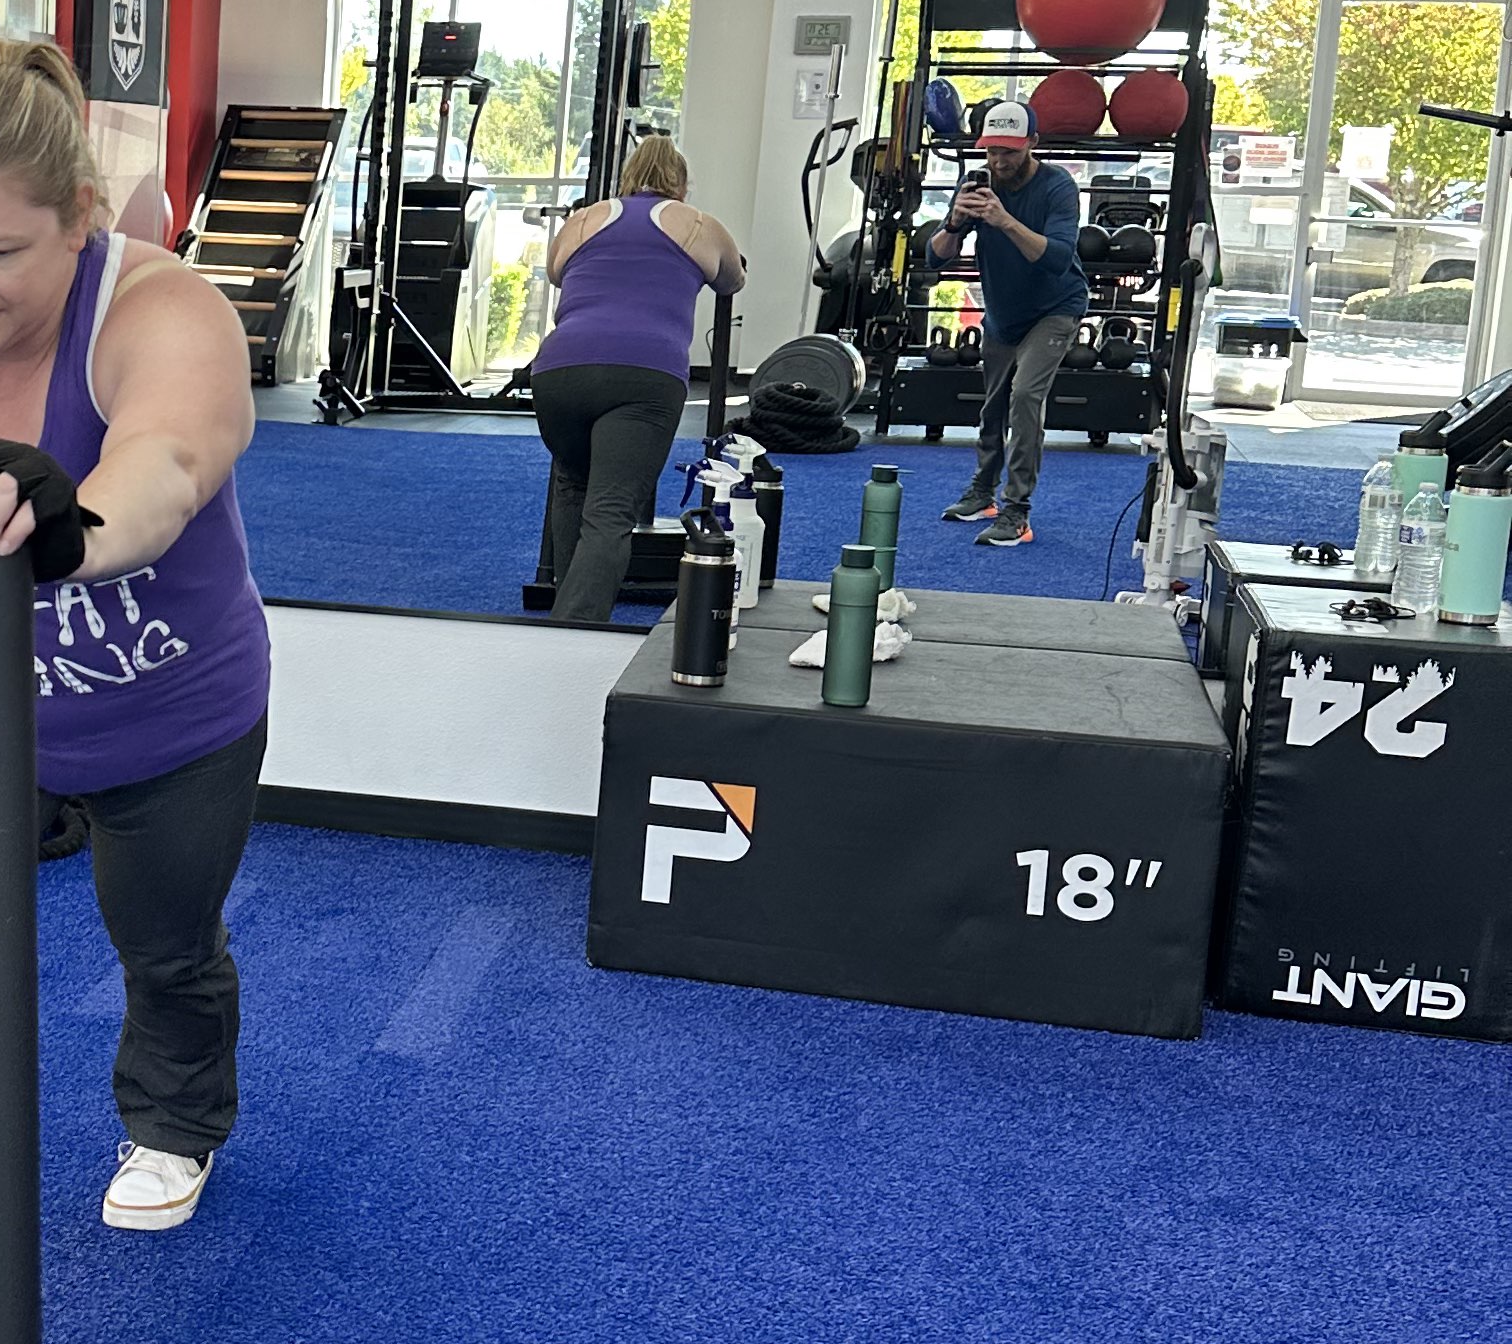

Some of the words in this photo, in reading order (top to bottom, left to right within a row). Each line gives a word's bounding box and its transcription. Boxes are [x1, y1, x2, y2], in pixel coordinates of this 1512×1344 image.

[1281, 650, 1457, 758] 24
[1272, 965, 1466, 1020] GIANT
[1278, 948, 1470, 983] LIFTING
